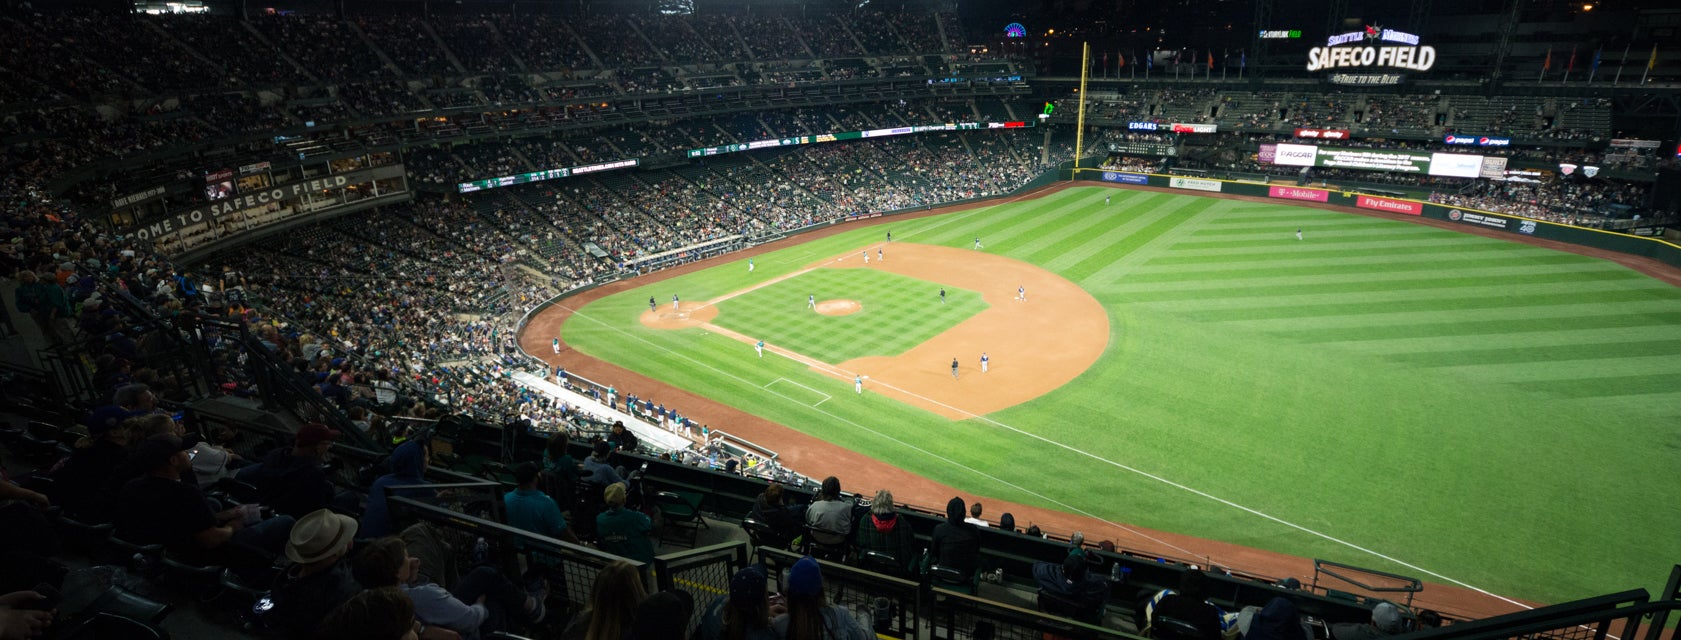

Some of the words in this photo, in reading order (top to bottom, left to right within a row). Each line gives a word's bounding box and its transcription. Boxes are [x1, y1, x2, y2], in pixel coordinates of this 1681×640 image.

[1306, 46, 1375, 72] SAFECO
[1377, 45, 1436, 72] FIELD
[1280, 150, 1313, 159] PACCAR
[177, 209, 203, 226] TO
[210, 188, 284, 217] SAFECO
[292, 175, 347, 196] FIELD
[1365, 198, 1378, 208] Fly
[1379, 200, 1412, 211] Emirates
